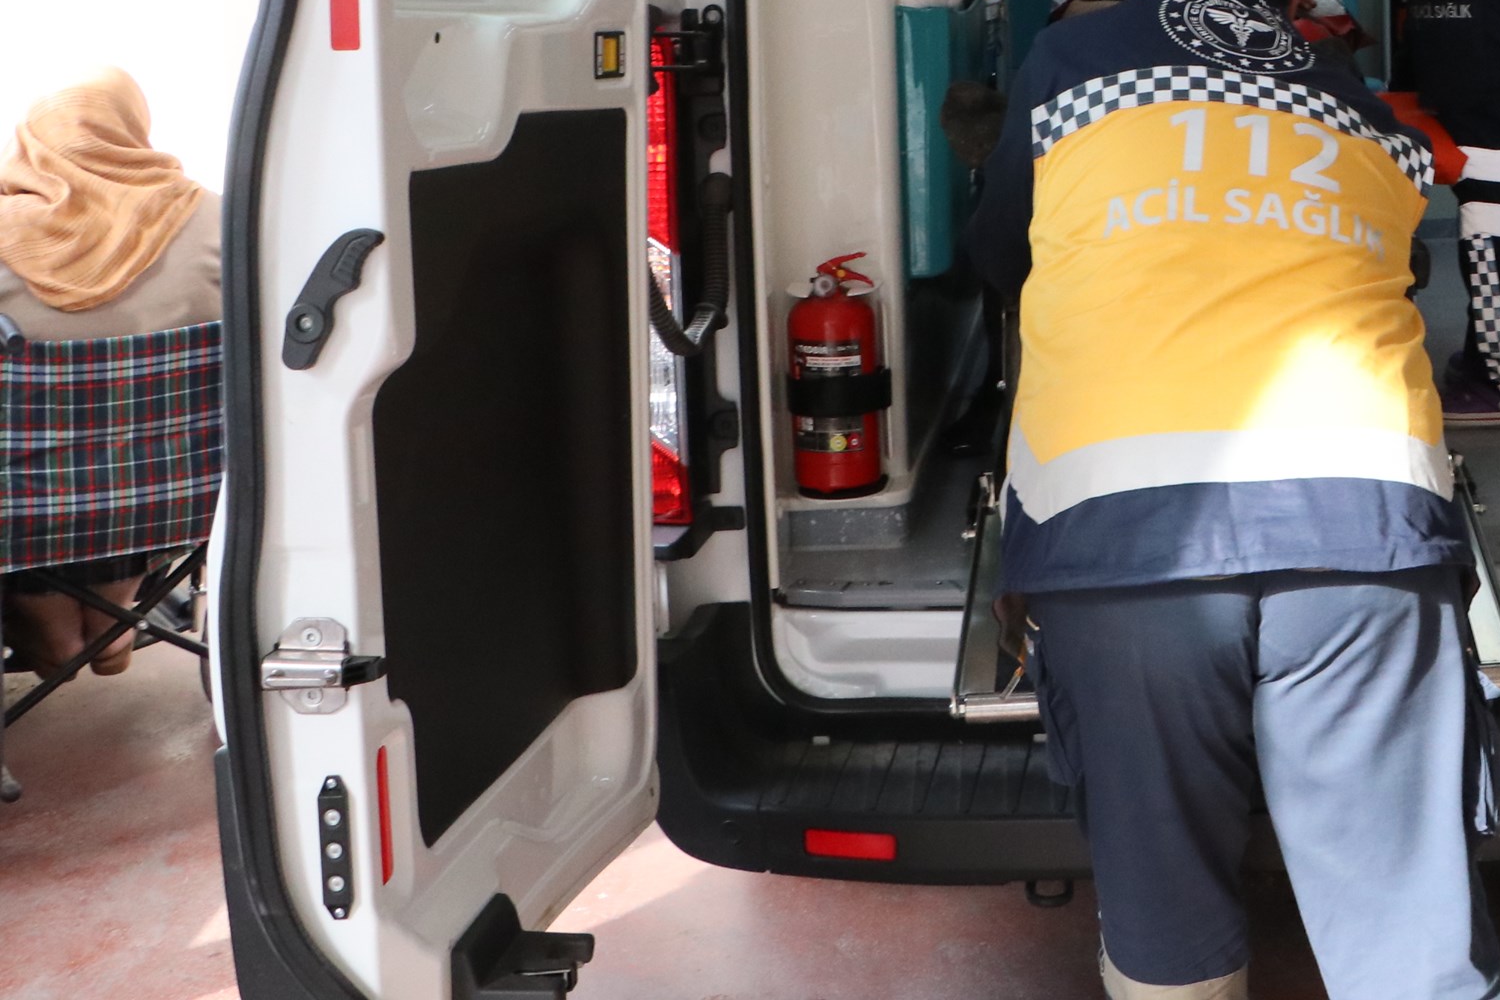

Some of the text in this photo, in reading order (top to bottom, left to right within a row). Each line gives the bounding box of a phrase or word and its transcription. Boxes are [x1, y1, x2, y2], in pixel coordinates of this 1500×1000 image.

[1170, 107, 1341, 194] 112
[1102, 178, 1385, 263] ACİL SAĞLIK
